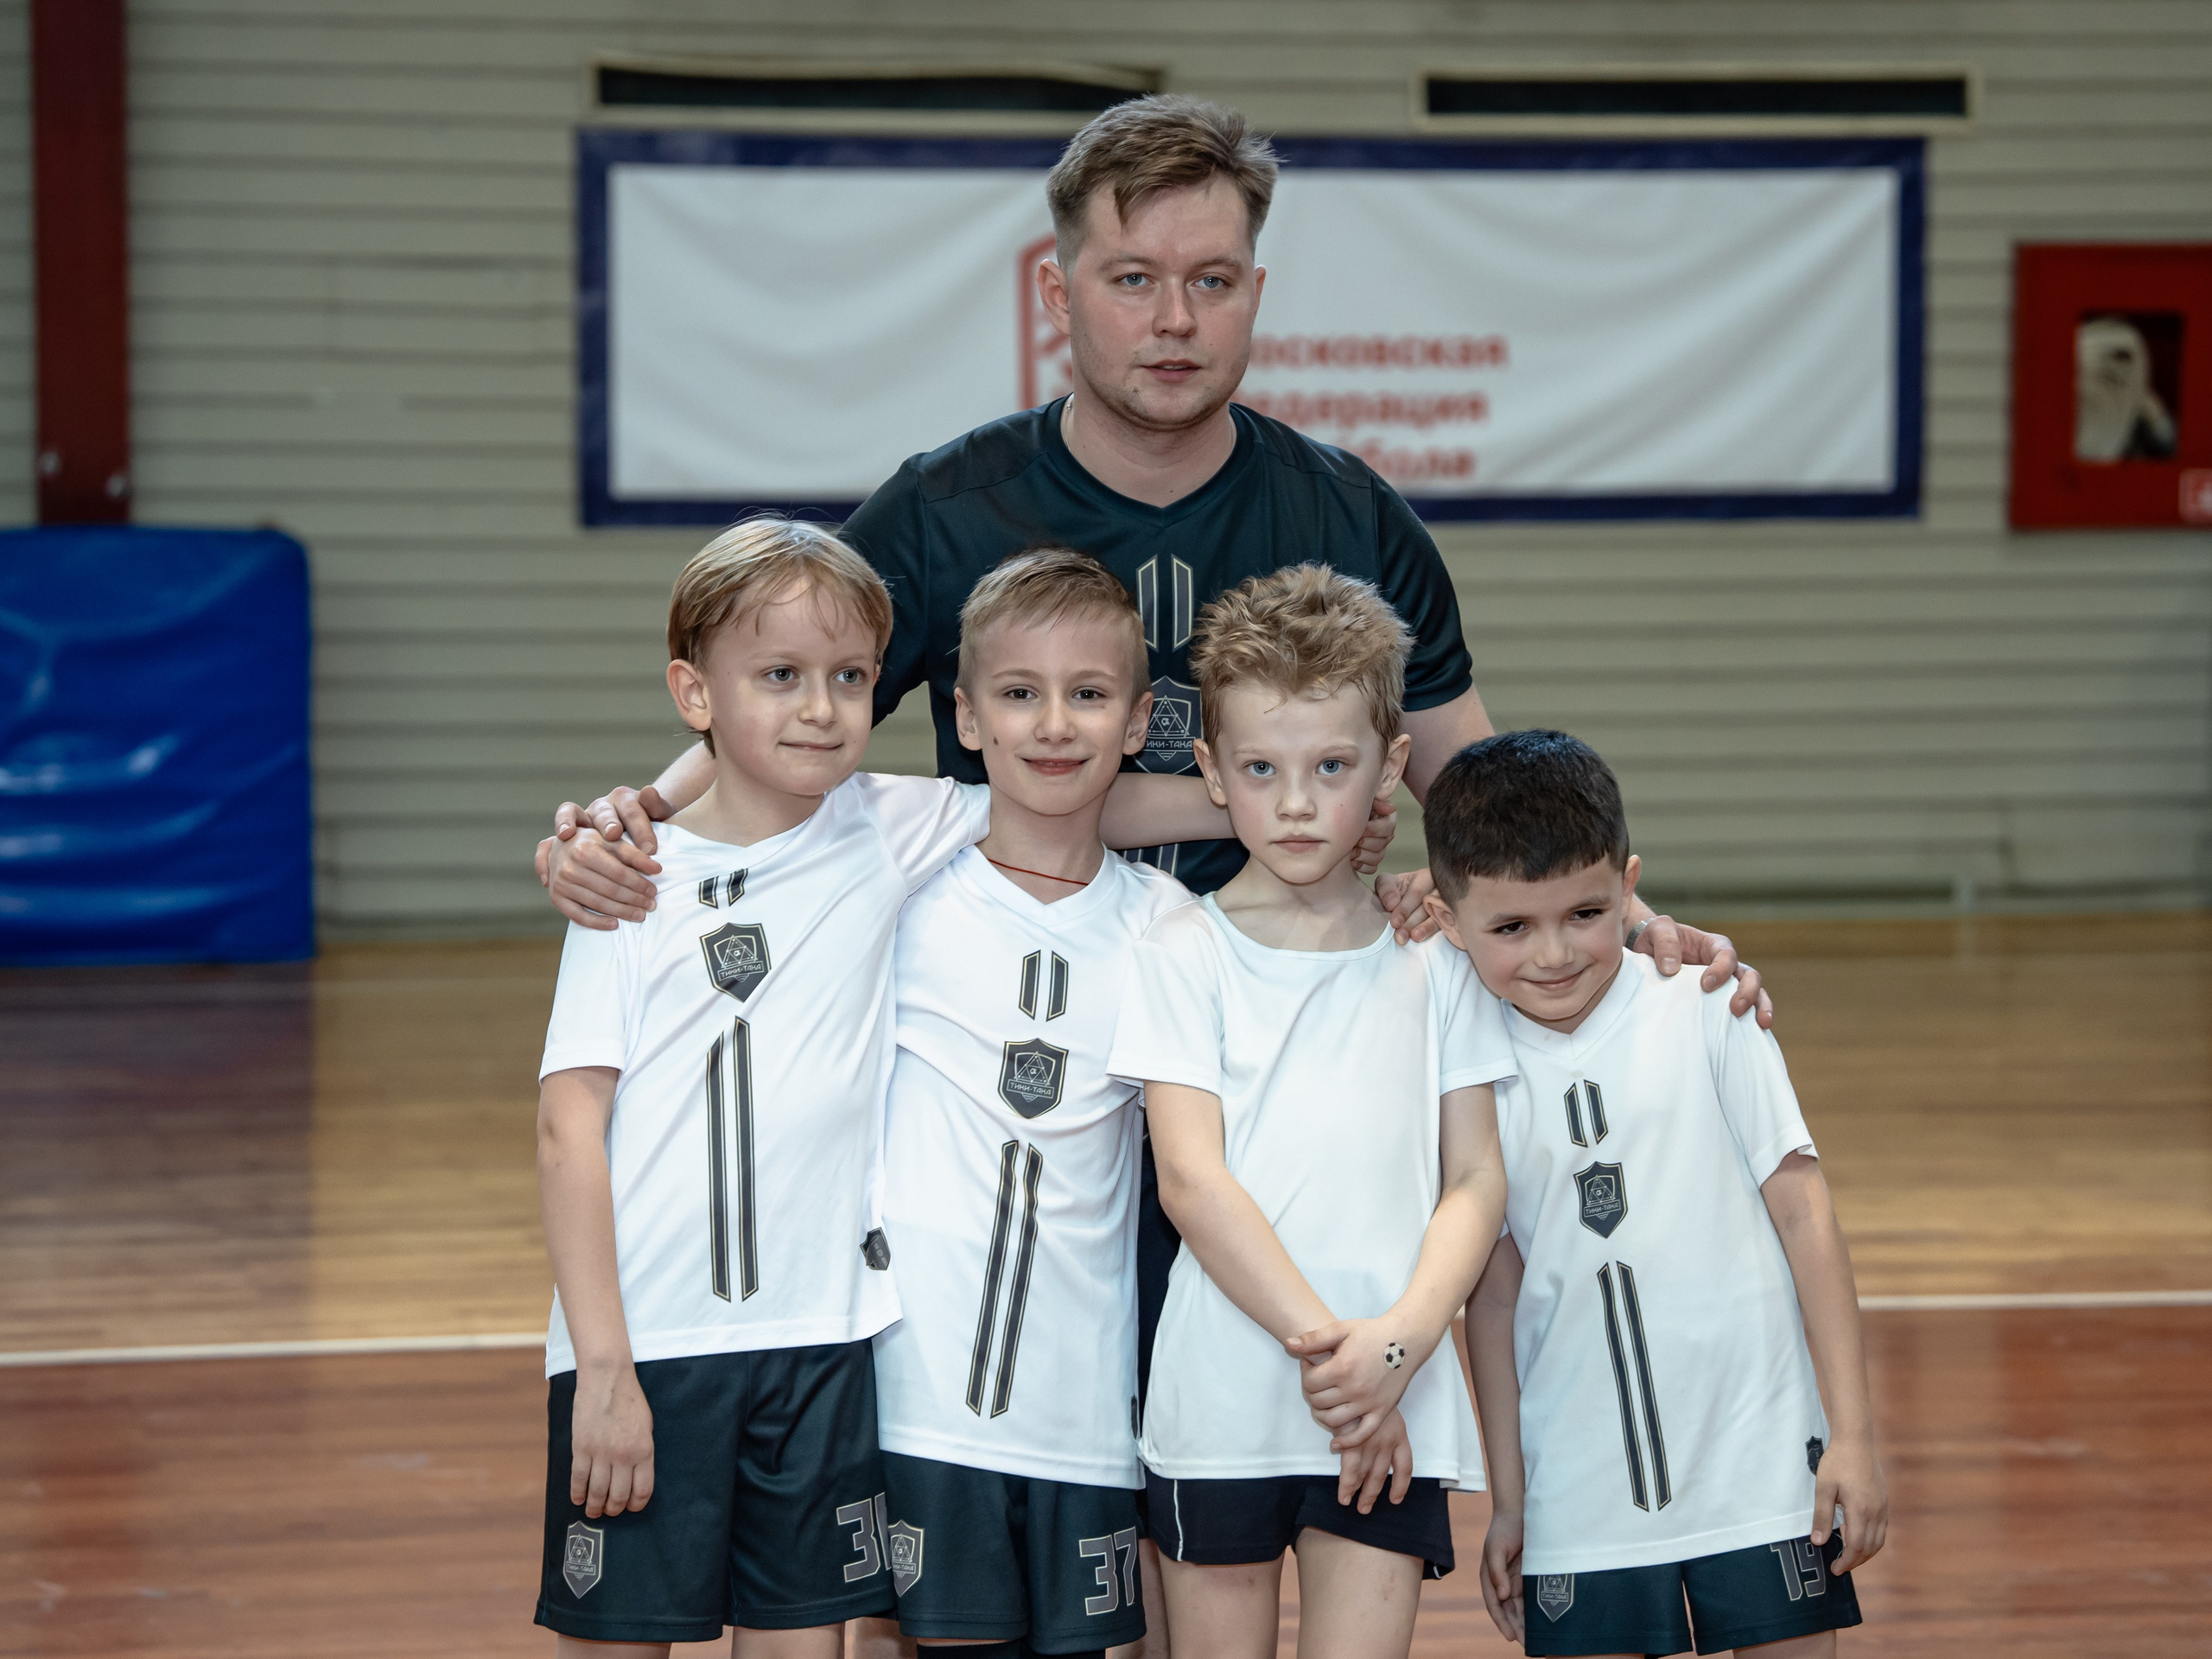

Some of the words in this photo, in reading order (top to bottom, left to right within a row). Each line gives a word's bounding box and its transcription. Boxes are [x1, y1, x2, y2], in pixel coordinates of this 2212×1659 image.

[1250, 334, 1509, 368] осковская
[1230, 392, 1490, 429] едерация
[1146, 740, 1192, 748] ИКИ-ТАКА
[1078, 1526, 1138, 1616] 37
[1769, 1535, 1827, 1601] 19
